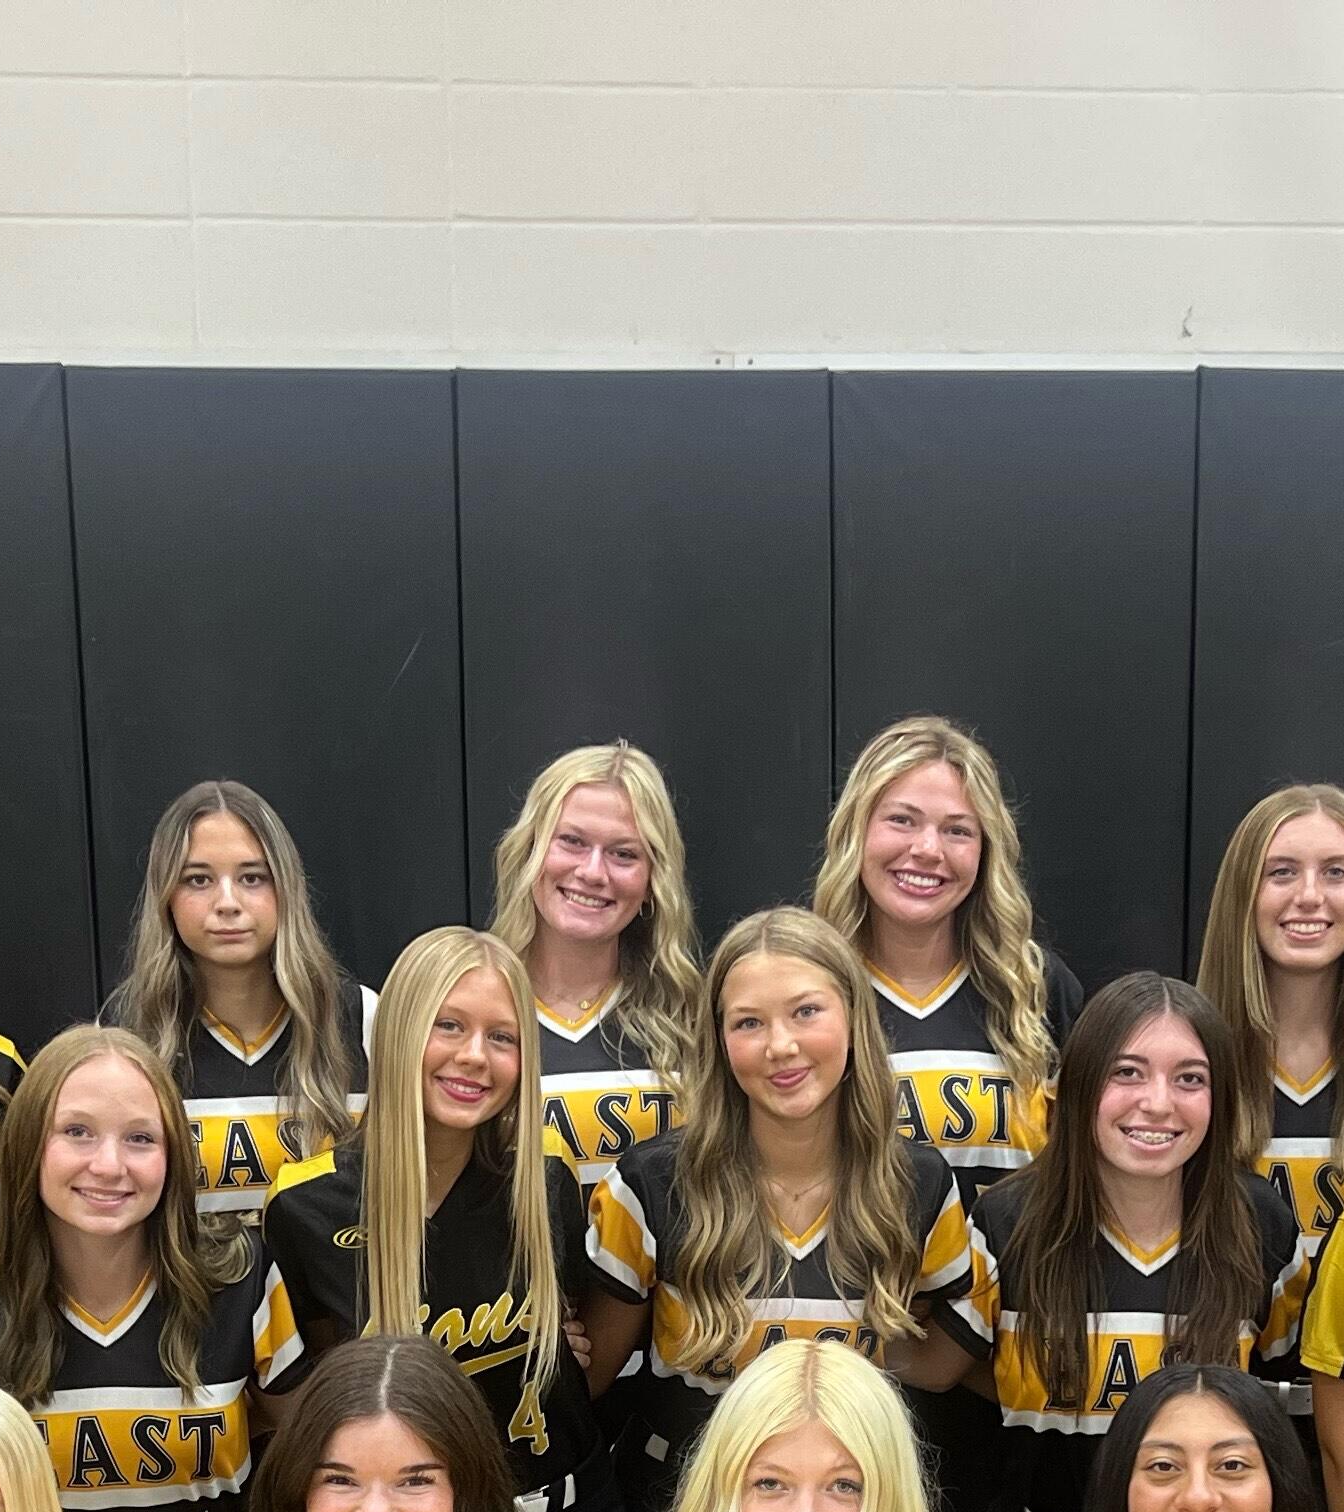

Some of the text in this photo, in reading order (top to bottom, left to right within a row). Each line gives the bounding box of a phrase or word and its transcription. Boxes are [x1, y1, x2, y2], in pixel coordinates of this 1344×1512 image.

[543, 1090, 676, 1161] AST
[894, 1073, 1015, 1145] AST
[34, 1411, 227, 1489] AST
[507, 1380, 550, 1456] 4
